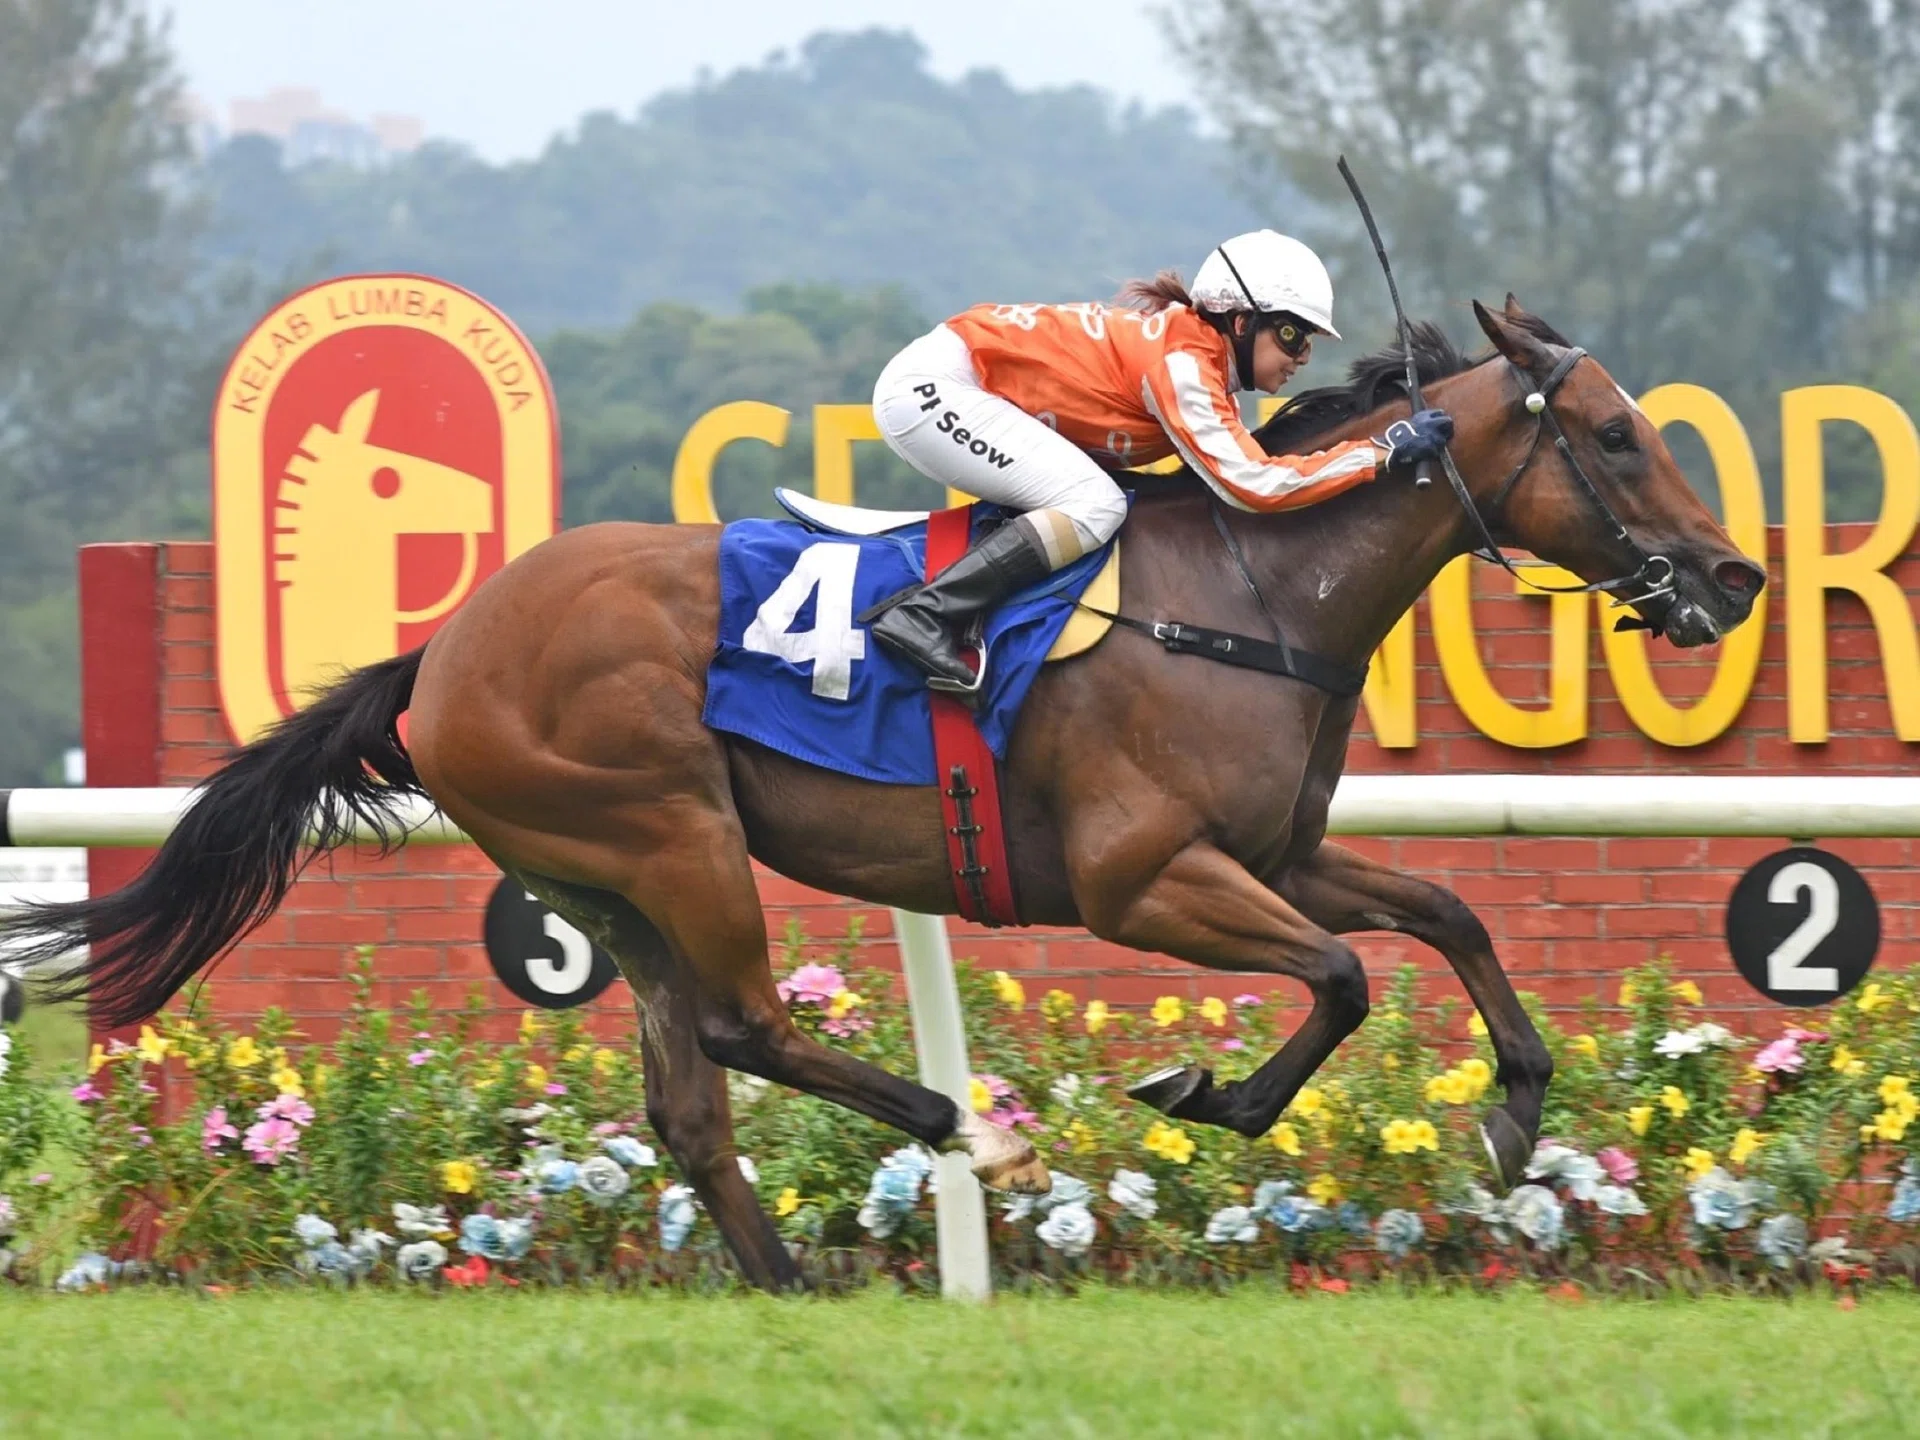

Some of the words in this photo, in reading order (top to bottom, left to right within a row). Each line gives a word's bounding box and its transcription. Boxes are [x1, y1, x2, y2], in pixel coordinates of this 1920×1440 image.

[231, 311, 314, 414] KELAB
[327, 288, 447, 325] LUMBA
[462, 317, 534, 413] KUDA
[936, 411, 1015, 470] Seow
[743, 542, 866, 701] 4
[525, 890, 593, 995] 3
[1767, 862, 1840, 991] 2
